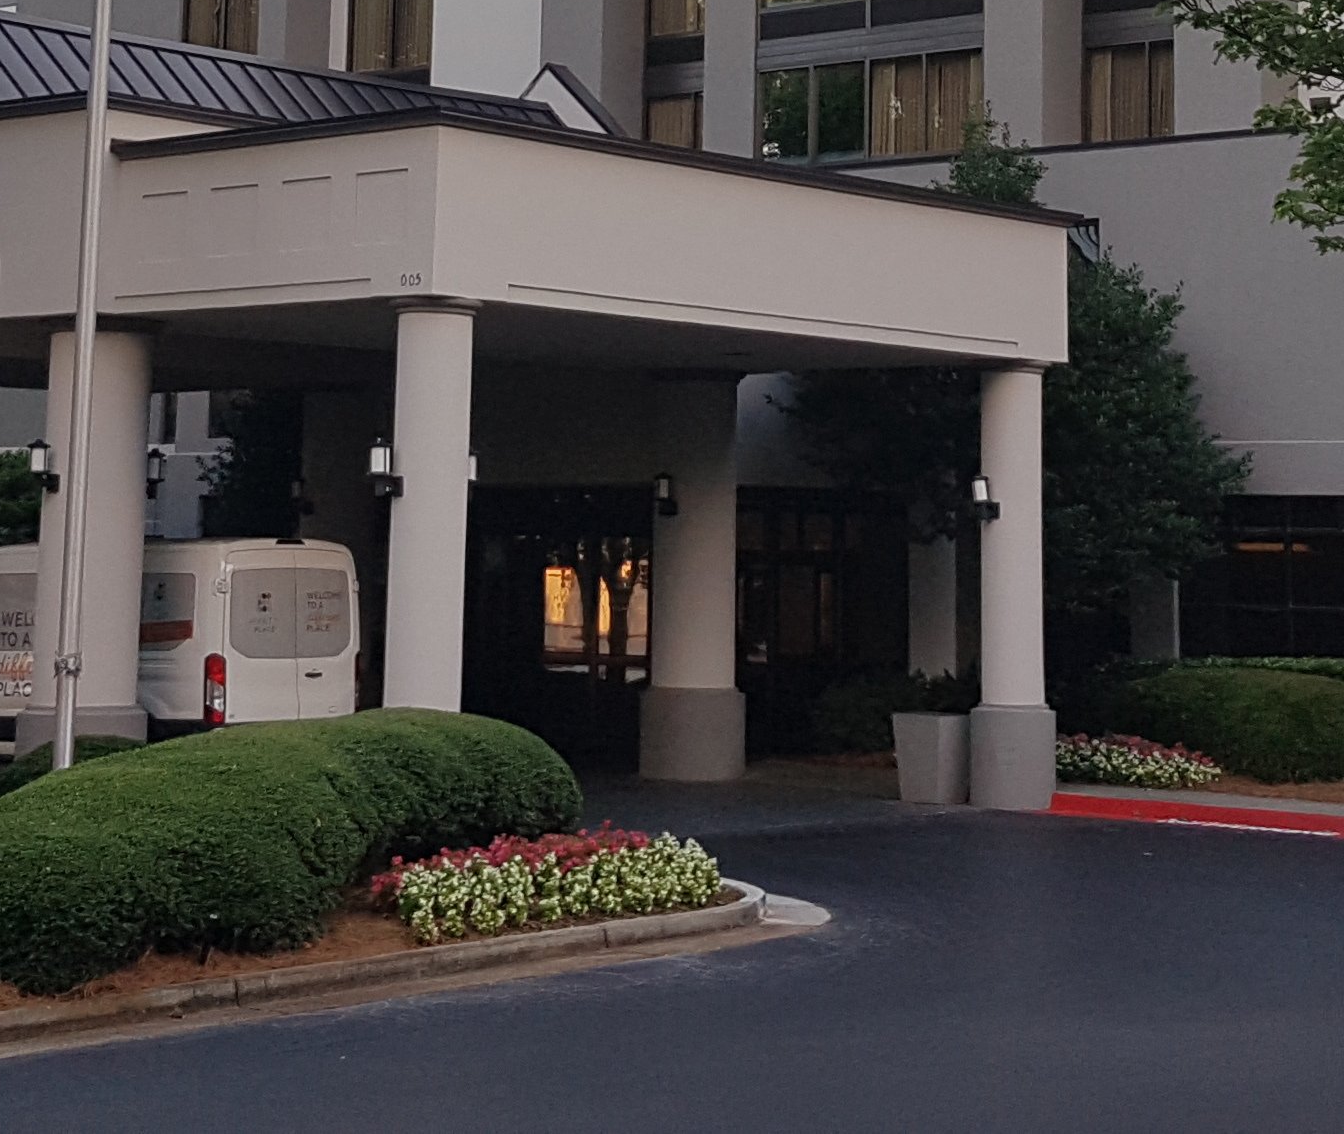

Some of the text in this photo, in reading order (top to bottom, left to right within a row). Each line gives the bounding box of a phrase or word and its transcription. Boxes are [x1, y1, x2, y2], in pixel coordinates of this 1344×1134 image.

[1, 611, 35, 628] WEL
[0, 631, 32, 647] TO A
